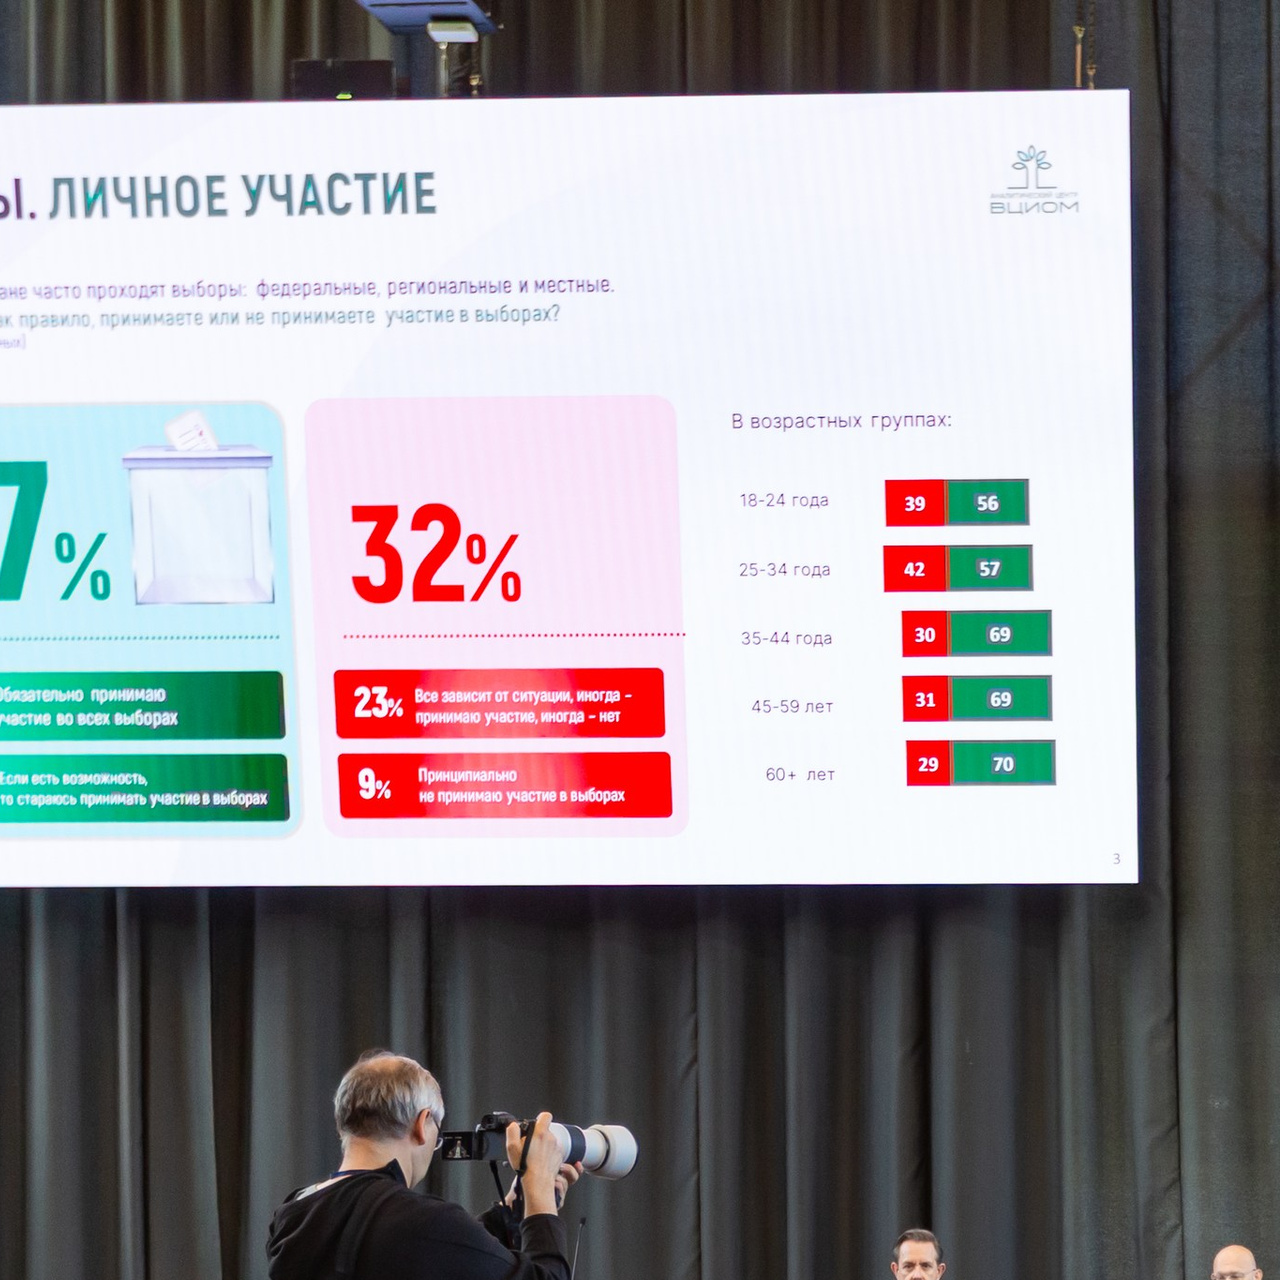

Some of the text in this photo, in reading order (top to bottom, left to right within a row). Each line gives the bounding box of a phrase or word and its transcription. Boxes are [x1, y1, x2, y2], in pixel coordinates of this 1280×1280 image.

[49, 174, 227, 219] ЛИЧНОЕ
[242, 172, 437, 217] УЧАСТИЕ
[990, 201, 1079, 215] ВЦИОМ
[33, 282, 83, 299] часто
[87, 281, 166, 301] проходят
[172, 279, 248, 300] выборы:
[256, 278, 381, 299] федеральные,
[387, 277, 512, 297] региональные
[519, 278, 529, 293] и
[534, 277, 615, 293] местные.
[20, 310, 95, 329] правило,
[101, 307, 203, 328] принимаете
[208, 308, 239, 325] или
[245, 307, 265, 324] не
[271, 306, 375, 326] принимаете
[386, 306, 454, 325] участие
[459, 307, 469, 322] в
[475, 303, 560, 323] выборах?
[732, 413, 952, 432] В возрастных группах:
[740, 493, 829, 508] 18-24 года
[905, 496, 926, 511] 39
[978, 496, 999, 510] 56
[0, 460, 112, 601] 7%
[350, 502, 522, 604] 32%
[739, 563, 831, 579] 25-34 года
[904, 562, 926, 577] 42
[980, 562, 1000, 576] 57
[741, 631, 833, 646] 35-44 года
[914, 627, 936, 642] 30
[989, 627, 1011, 642] 69
[91, 686, 166, 705] принимаю
[354, 685, 403, 718] 23%
[414, 688, 438, 703] Все
[441, 689, 492, 704] зависит
[495, 690, 508, 703] от
[512, 688, 574, 705] ситуации,
[577, 688, 621, 703] иногда
[915, 692, 936, 707] 31
[990, 692, 1011, 707] 69
[752, 699, 833, 714] 45-59 лет
[56, 711, 73, 726] во
[77, 711, 110, 726] всех
[115, 708, 179, 728] выборах
[416, 709, 481, 725] принимаю
[485, 709, 539, 726] участие,
[541, 708, 584, 724] иногда
[599, 709, 621, 722] нет
[918, 757, 939, 772] 29
[993, 757, 1014, 772] 70
[32, 773, 59, 785] есть
[62, 770, 148, 787] возможность,
[418, 767, 517, 784] Принципиально
[766, 767, 835, 782] 60+ лет
[358, 767, 391, 801] 9%
[17, 793, 77, 808] стараюсь
[80, 792, 147, 808] принимать
[150, 792, 200, 808] участие
[203, 793, 210, 805] в
[213, 790, 268, 807] выборах
[419, 786, 625, 806] не принимаю участие в выборах
[1112, 852, 1121, 865] 3
